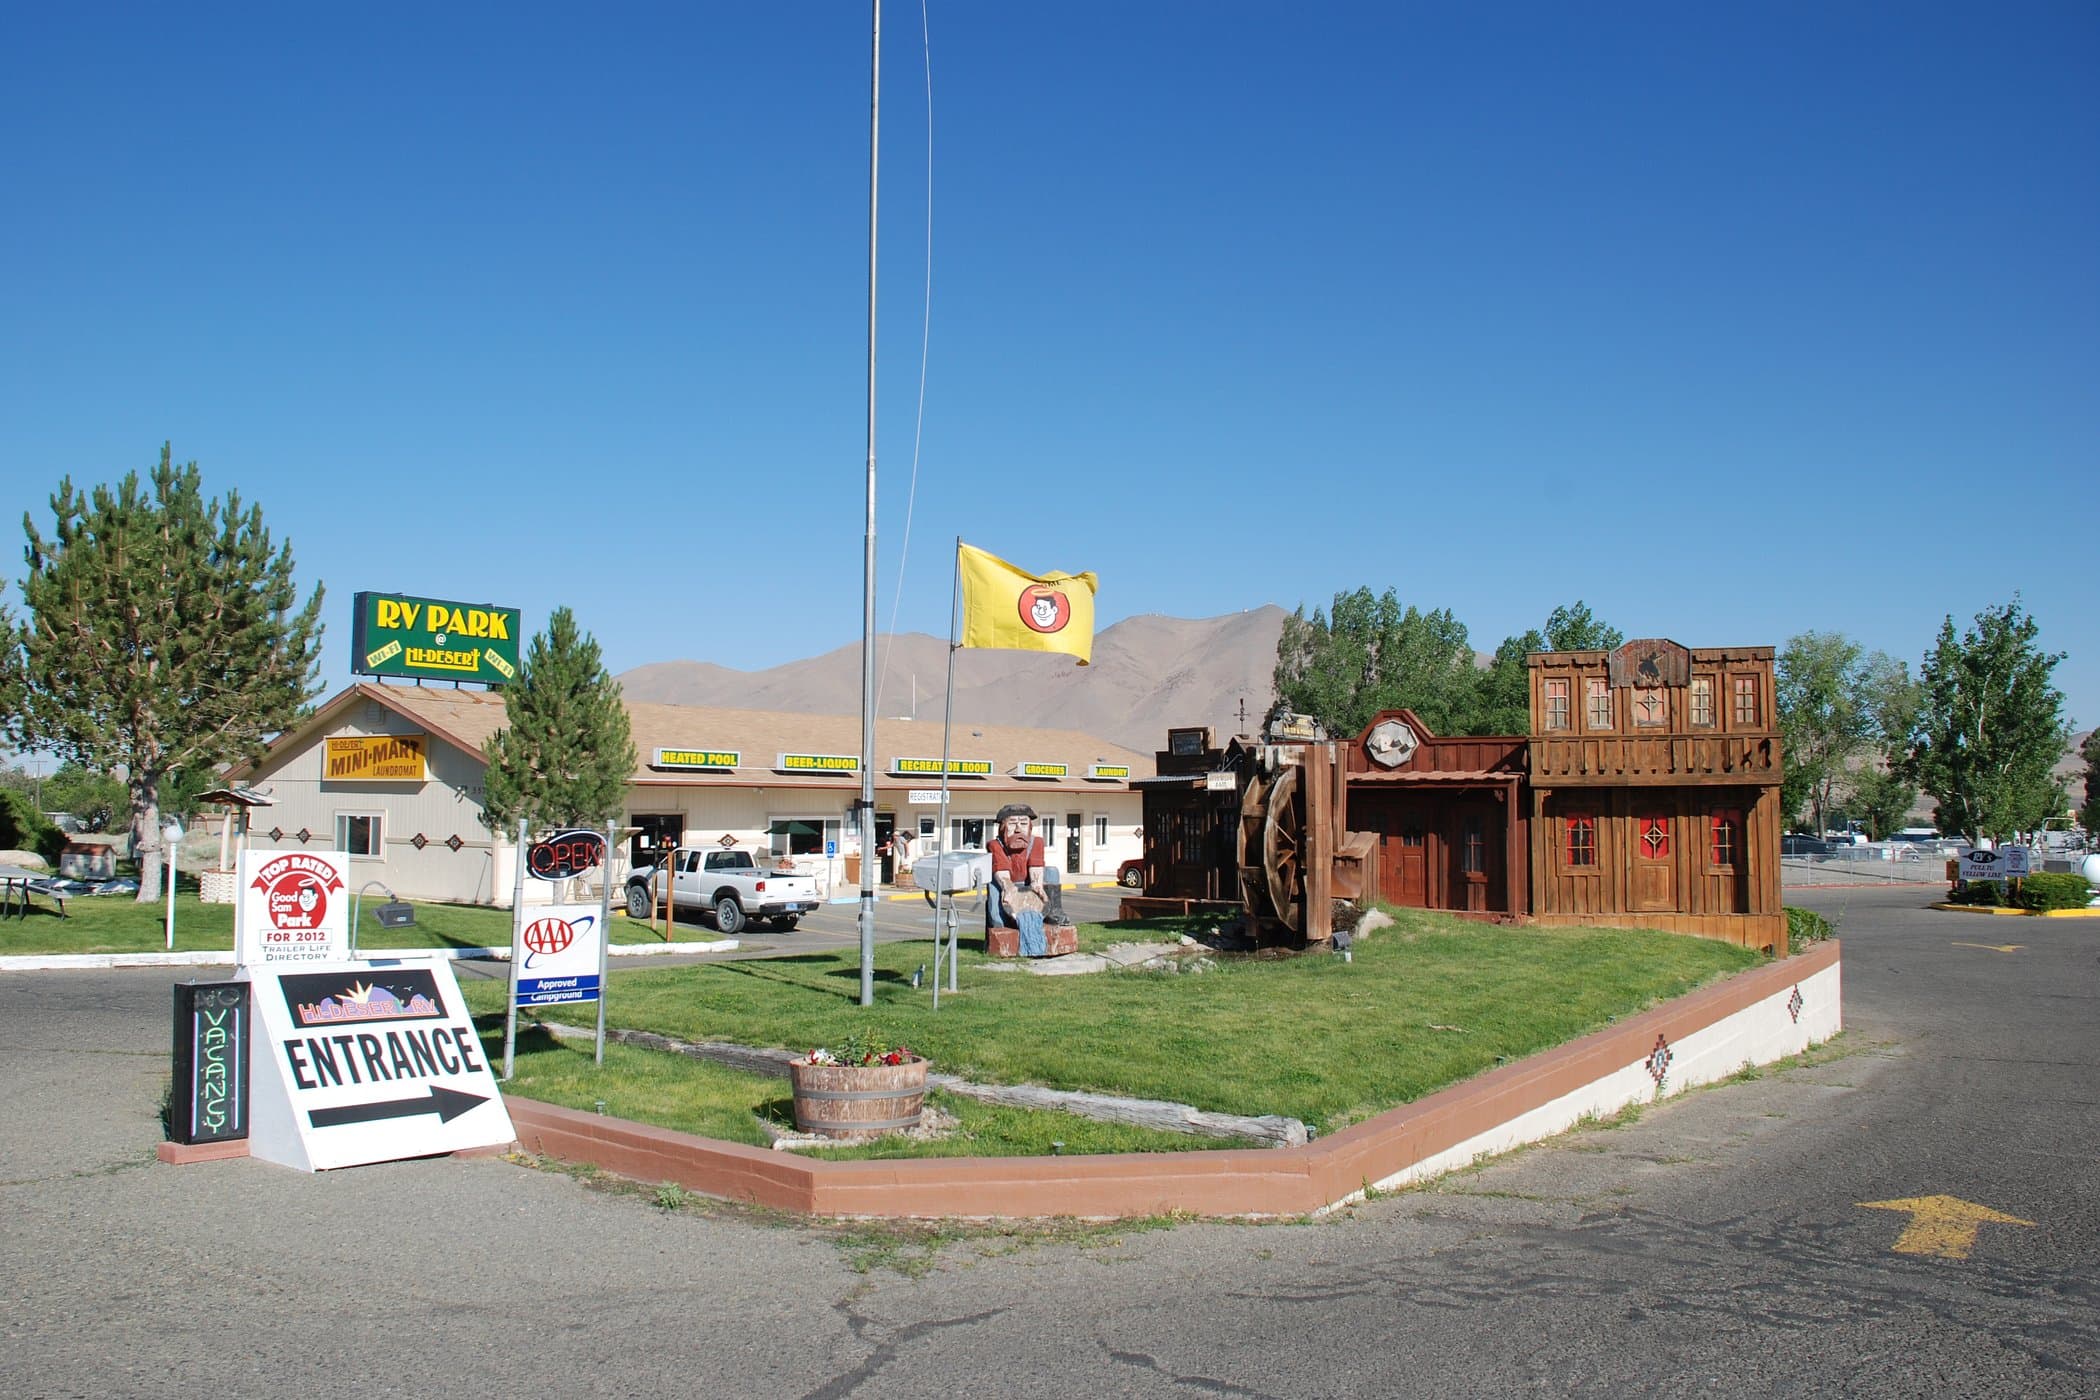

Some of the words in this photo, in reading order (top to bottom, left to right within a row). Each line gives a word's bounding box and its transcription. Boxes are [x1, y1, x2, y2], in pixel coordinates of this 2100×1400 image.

[377, 599, 421, 631] RV
[427, 605, 509, 640] PARK
[435, 633, 447, 646] @
[369, 642, 399, 665] WI-FI
[405, 647, 480, 671] HI-DESERT
[487, 650, 513, 676] WI-FI
[331, 739, 420, 777] MINI-MART
[661, 751, 705, 765] HEATED
[708, 753, 737, 766] POOL
[785, 756, 856, 769] BEER-LIQUOR
[373, 765, 417, 777] LAUNDROMAT
[900, 760, 961, 772] RECREATON
[962, 761, 989, 773] ROOM
[1025, 764, 1065, 775] GROCERIES
[1095, 767, 1128, 777] LAUNDRY
[910, 792, 949, 801] REGISTRATIN
[531, 840, 605, 872] OPEN
[261, 859, 290, 880] TOP
[291, 857, 333, 880] RATED
[271, 891, 298, 902] Good
[271, 902, 292, 912] Sam
[277, 911, 312, 927] Park
[266, 932, 290, 942] FOR
[296, 931, 326, 942] 2012
[528, 919, 569, 953] AAA
[266, 953, 328, 961] DIRECTORY
[537, 978, 577, 991] Approved
[531, 990, 582, 1002] Campground
[411, 998, 436, 1014] RV
[283, 1027, 483, 1090] ENTRANCE
[204, 1008, 228, 1135] VACANCY
